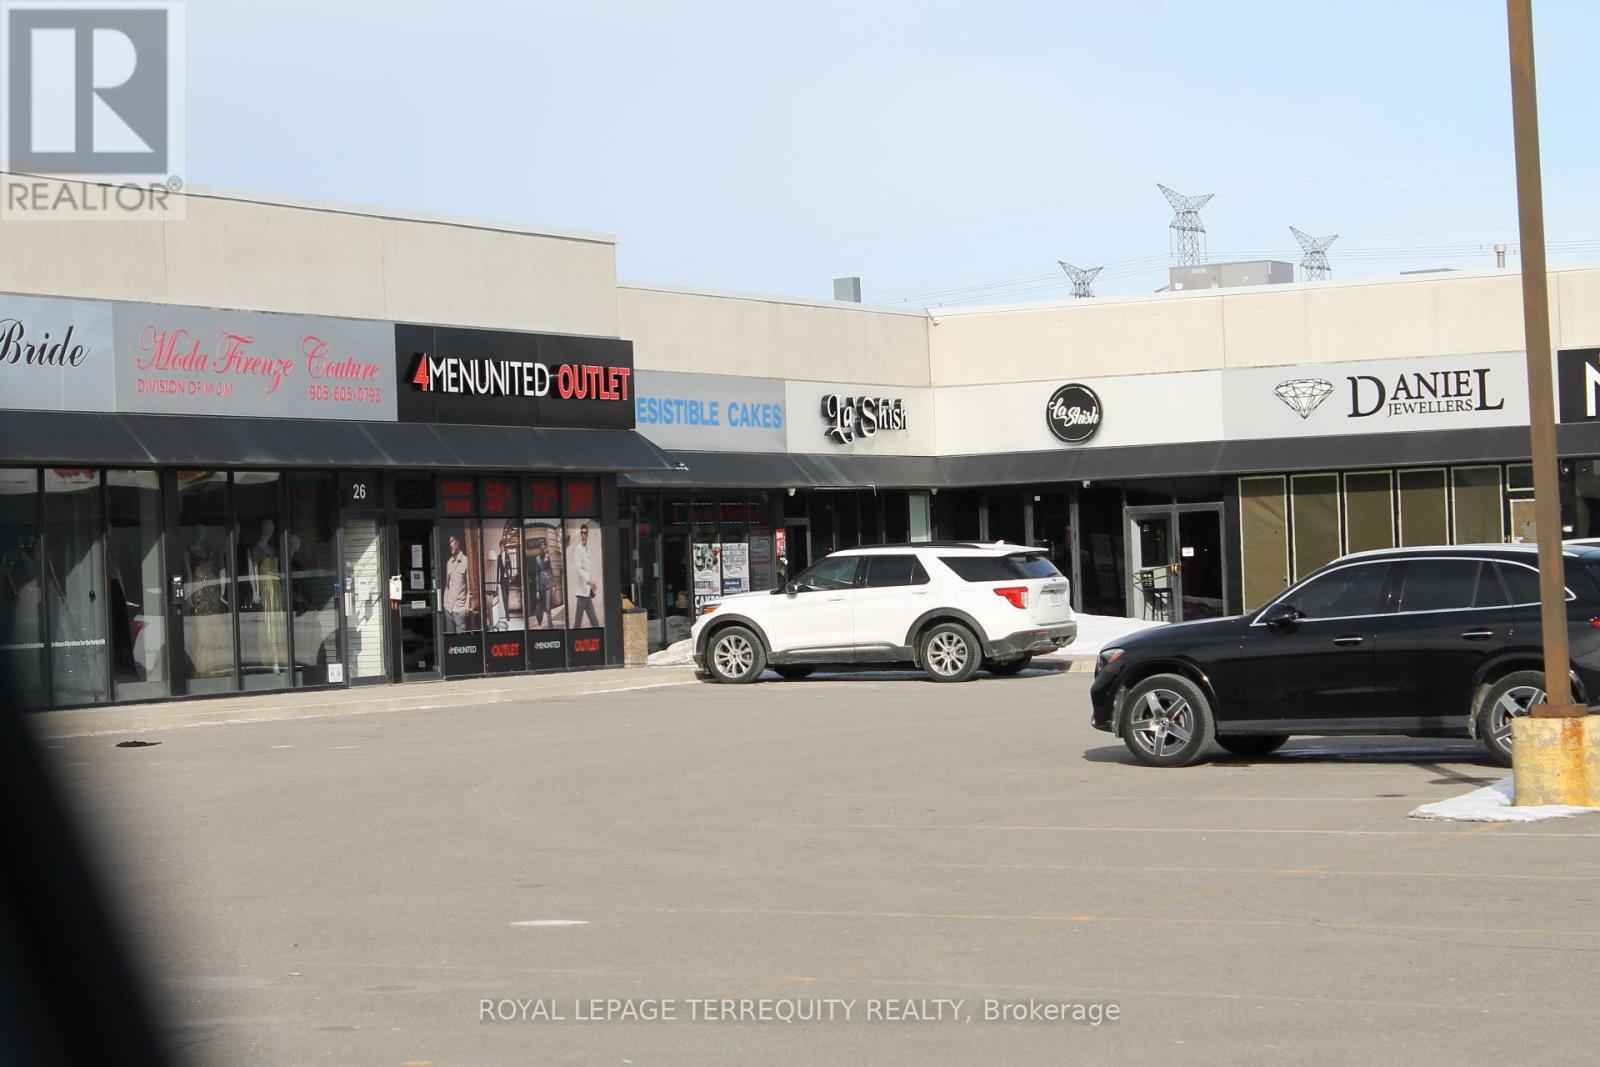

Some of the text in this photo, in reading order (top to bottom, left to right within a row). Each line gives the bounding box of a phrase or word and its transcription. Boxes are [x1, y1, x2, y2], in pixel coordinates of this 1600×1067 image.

[0, 318, 91, 367] Bride
[136, 325, 380, 394] Moda Firenze Couture
[137, 378, 184, 394] DIVISION
[187, 381, 201, 395] OF
[557, 363, 631, 400] OUTLET
[1347, 368, 1505, 418] DANIEL
[728, 402, 783, 429] CAKES
[857, 395, 908, 438] Shish
[1048, 397, 1100, 427] La Shish
[1387, 399, 1473, 417] JEWELLERS
[353, 483, 366, 499] 26
